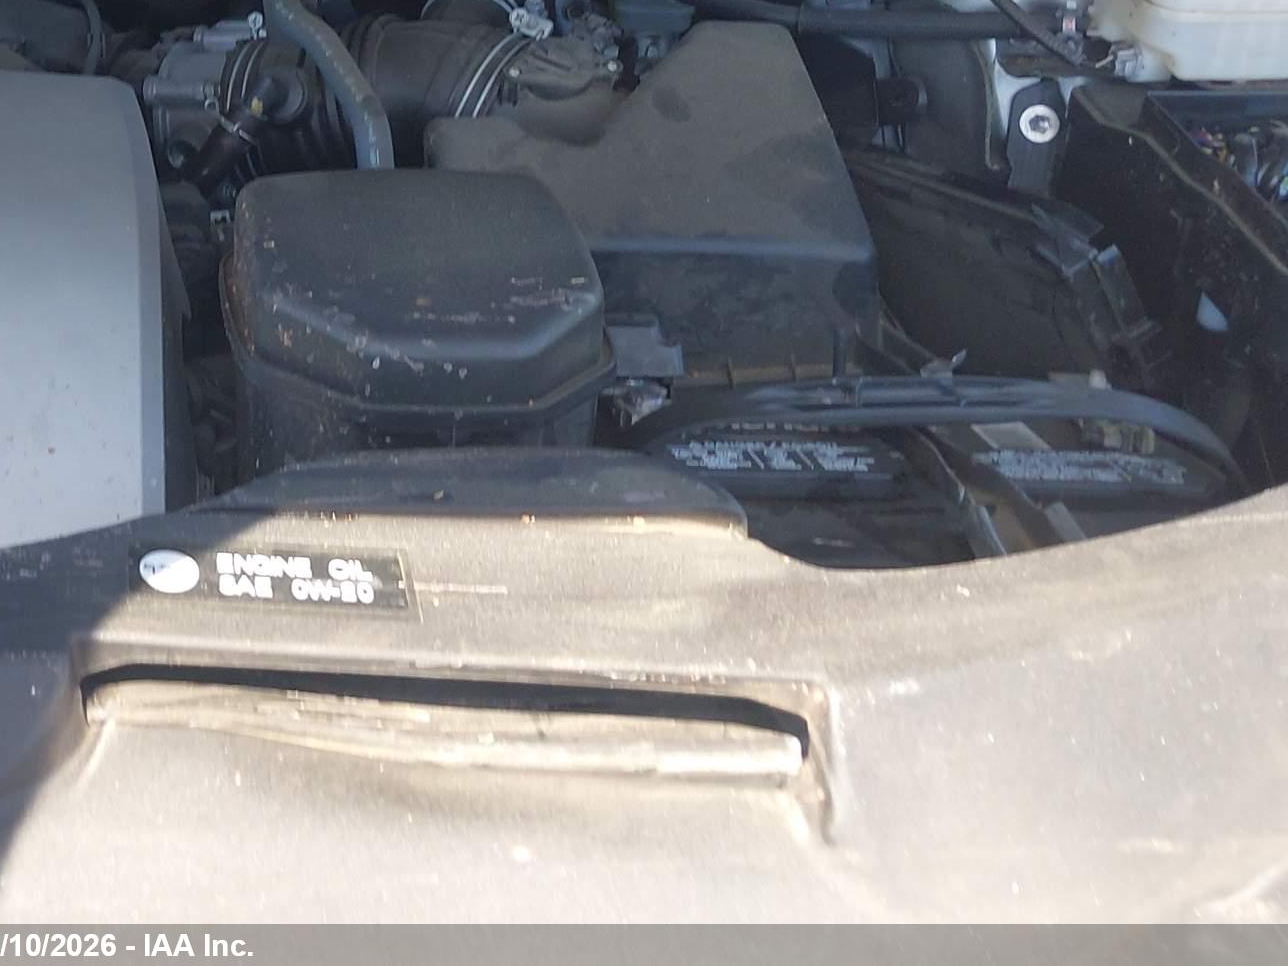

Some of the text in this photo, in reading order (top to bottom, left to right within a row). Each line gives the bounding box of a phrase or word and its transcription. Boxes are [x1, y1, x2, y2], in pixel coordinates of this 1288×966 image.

[216, 552, 373, 582] ENGINE OIL
[219, 574, 375, 604] SAE 0W-20
